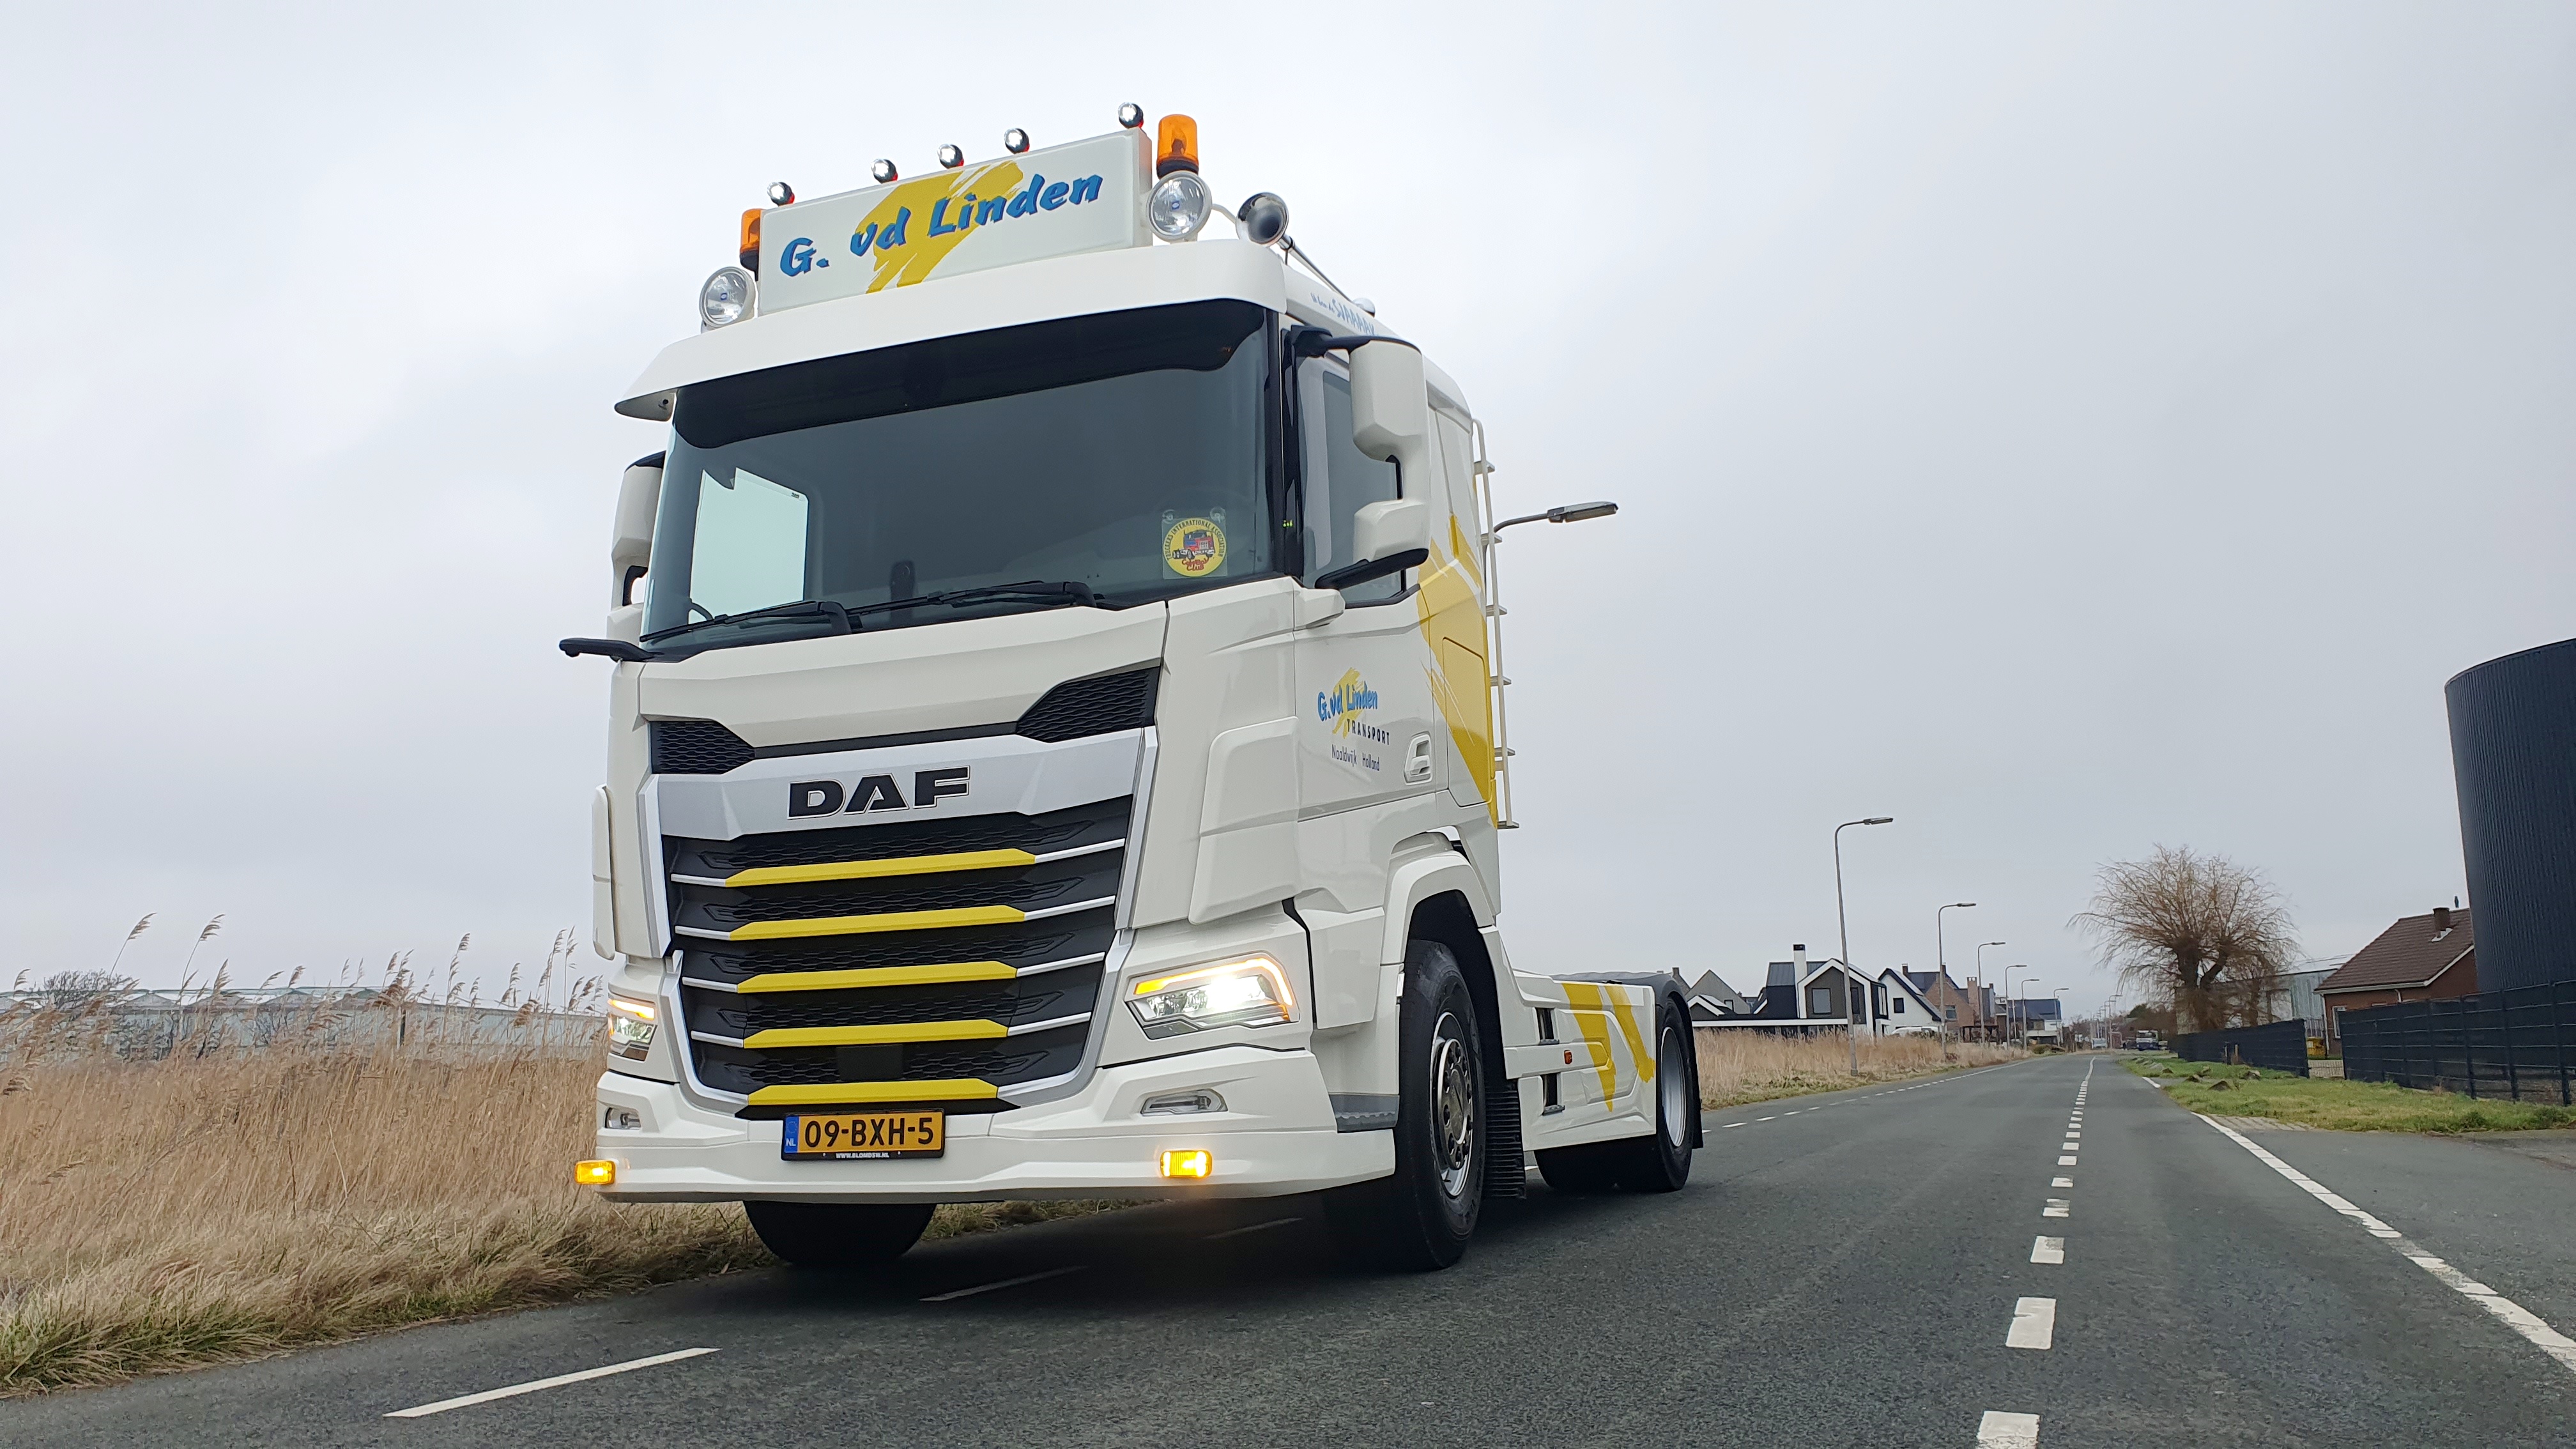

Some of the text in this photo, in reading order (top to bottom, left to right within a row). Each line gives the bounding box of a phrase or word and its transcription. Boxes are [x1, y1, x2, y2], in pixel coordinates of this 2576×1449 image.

[779, 173, 1103, 277] G. vd Linden
[1172, 519, 1211, 535] INTERNATIONAL
[1346, 681, 1378, 712] Linden
[1347, 719, 1390, 745] TRANSPORT
[1331, 744, 1380, 771] Naaldwijk Holland
[787, 765, 970, 820] DAF
[786, 1138, 796, 1147] NL
[804, 1117, 933, 1148] 09-BXH-5
